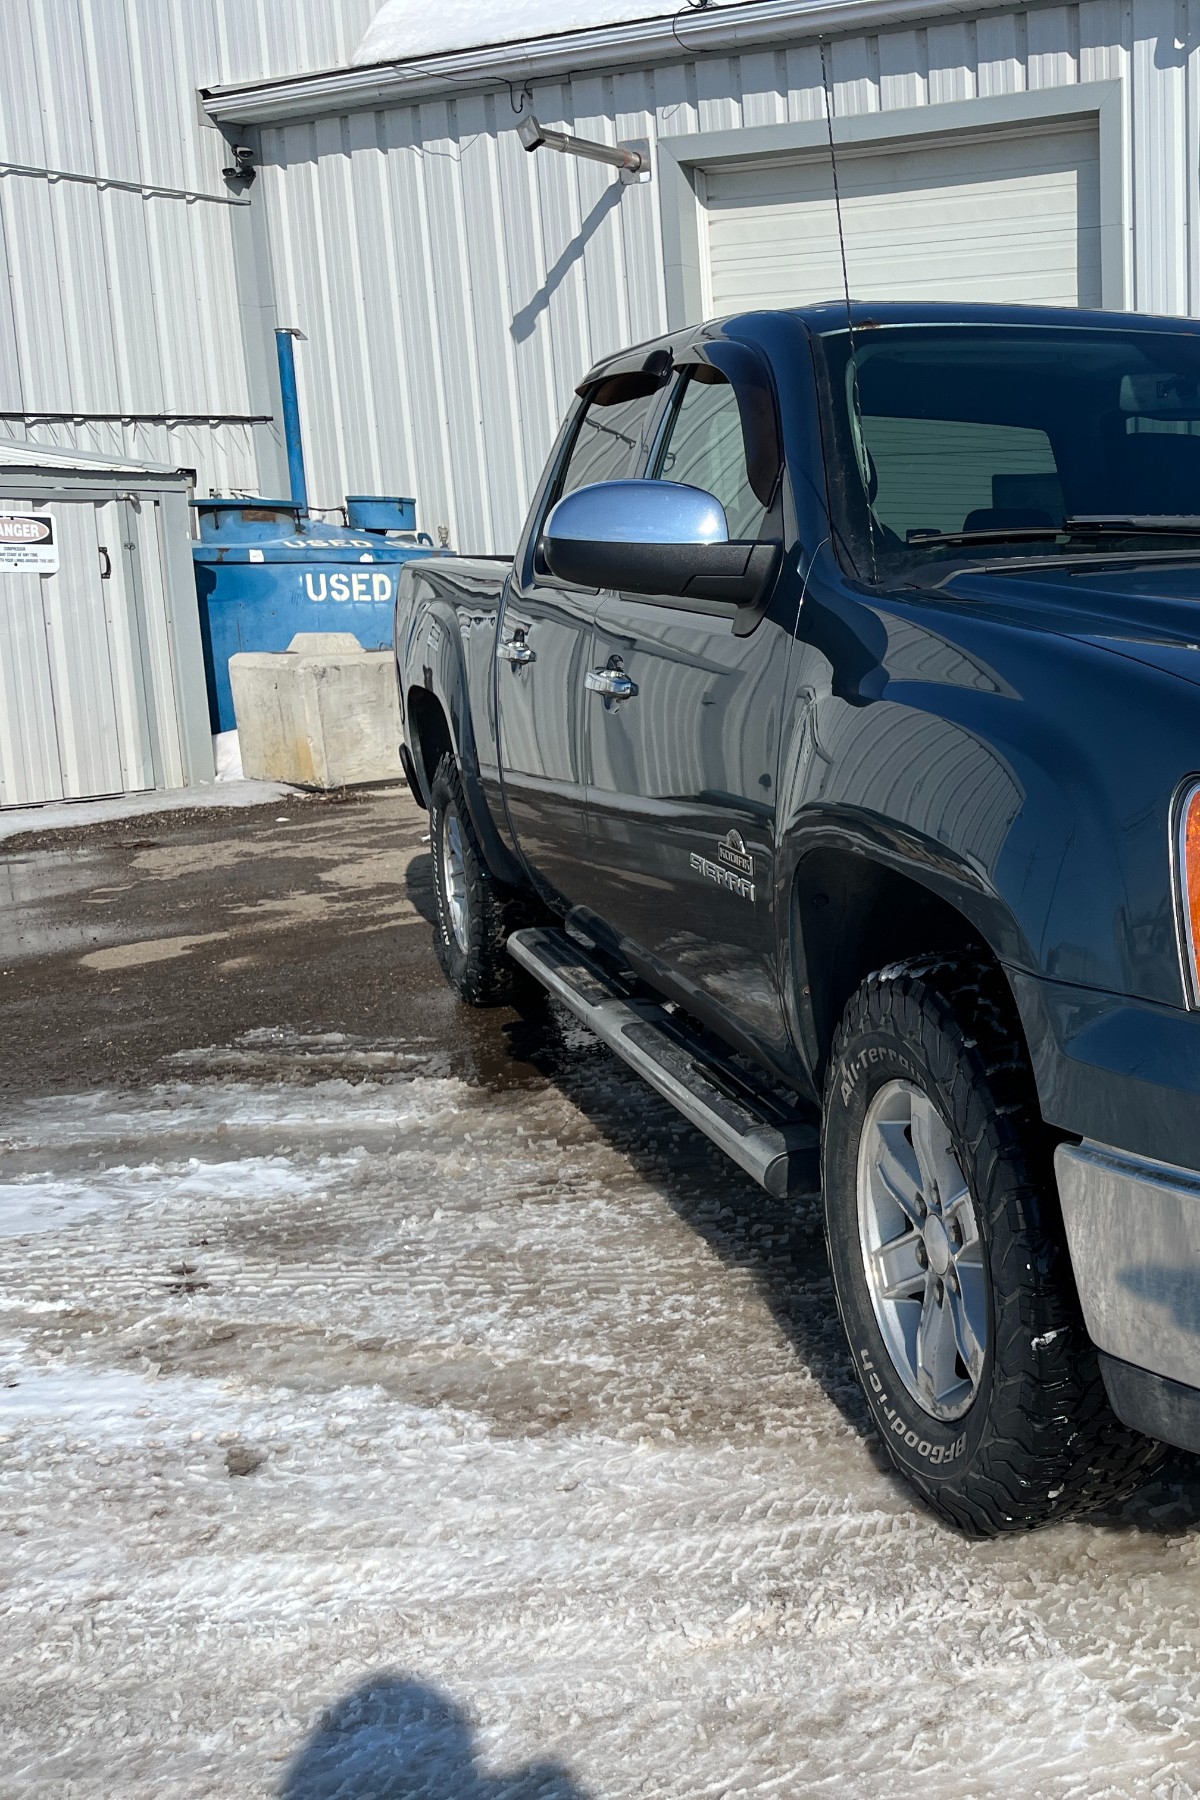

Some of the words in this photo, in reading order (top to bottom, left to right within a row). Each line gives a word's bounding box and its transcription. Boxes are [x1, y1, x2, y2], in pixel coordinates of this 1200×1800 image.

[283, 539, 373, 548] USED
[305, 573, 392, 602] USED
[690, 852, 756, 902] SIERRA
[860, 1349, 967, 1464] BFGoodrich
